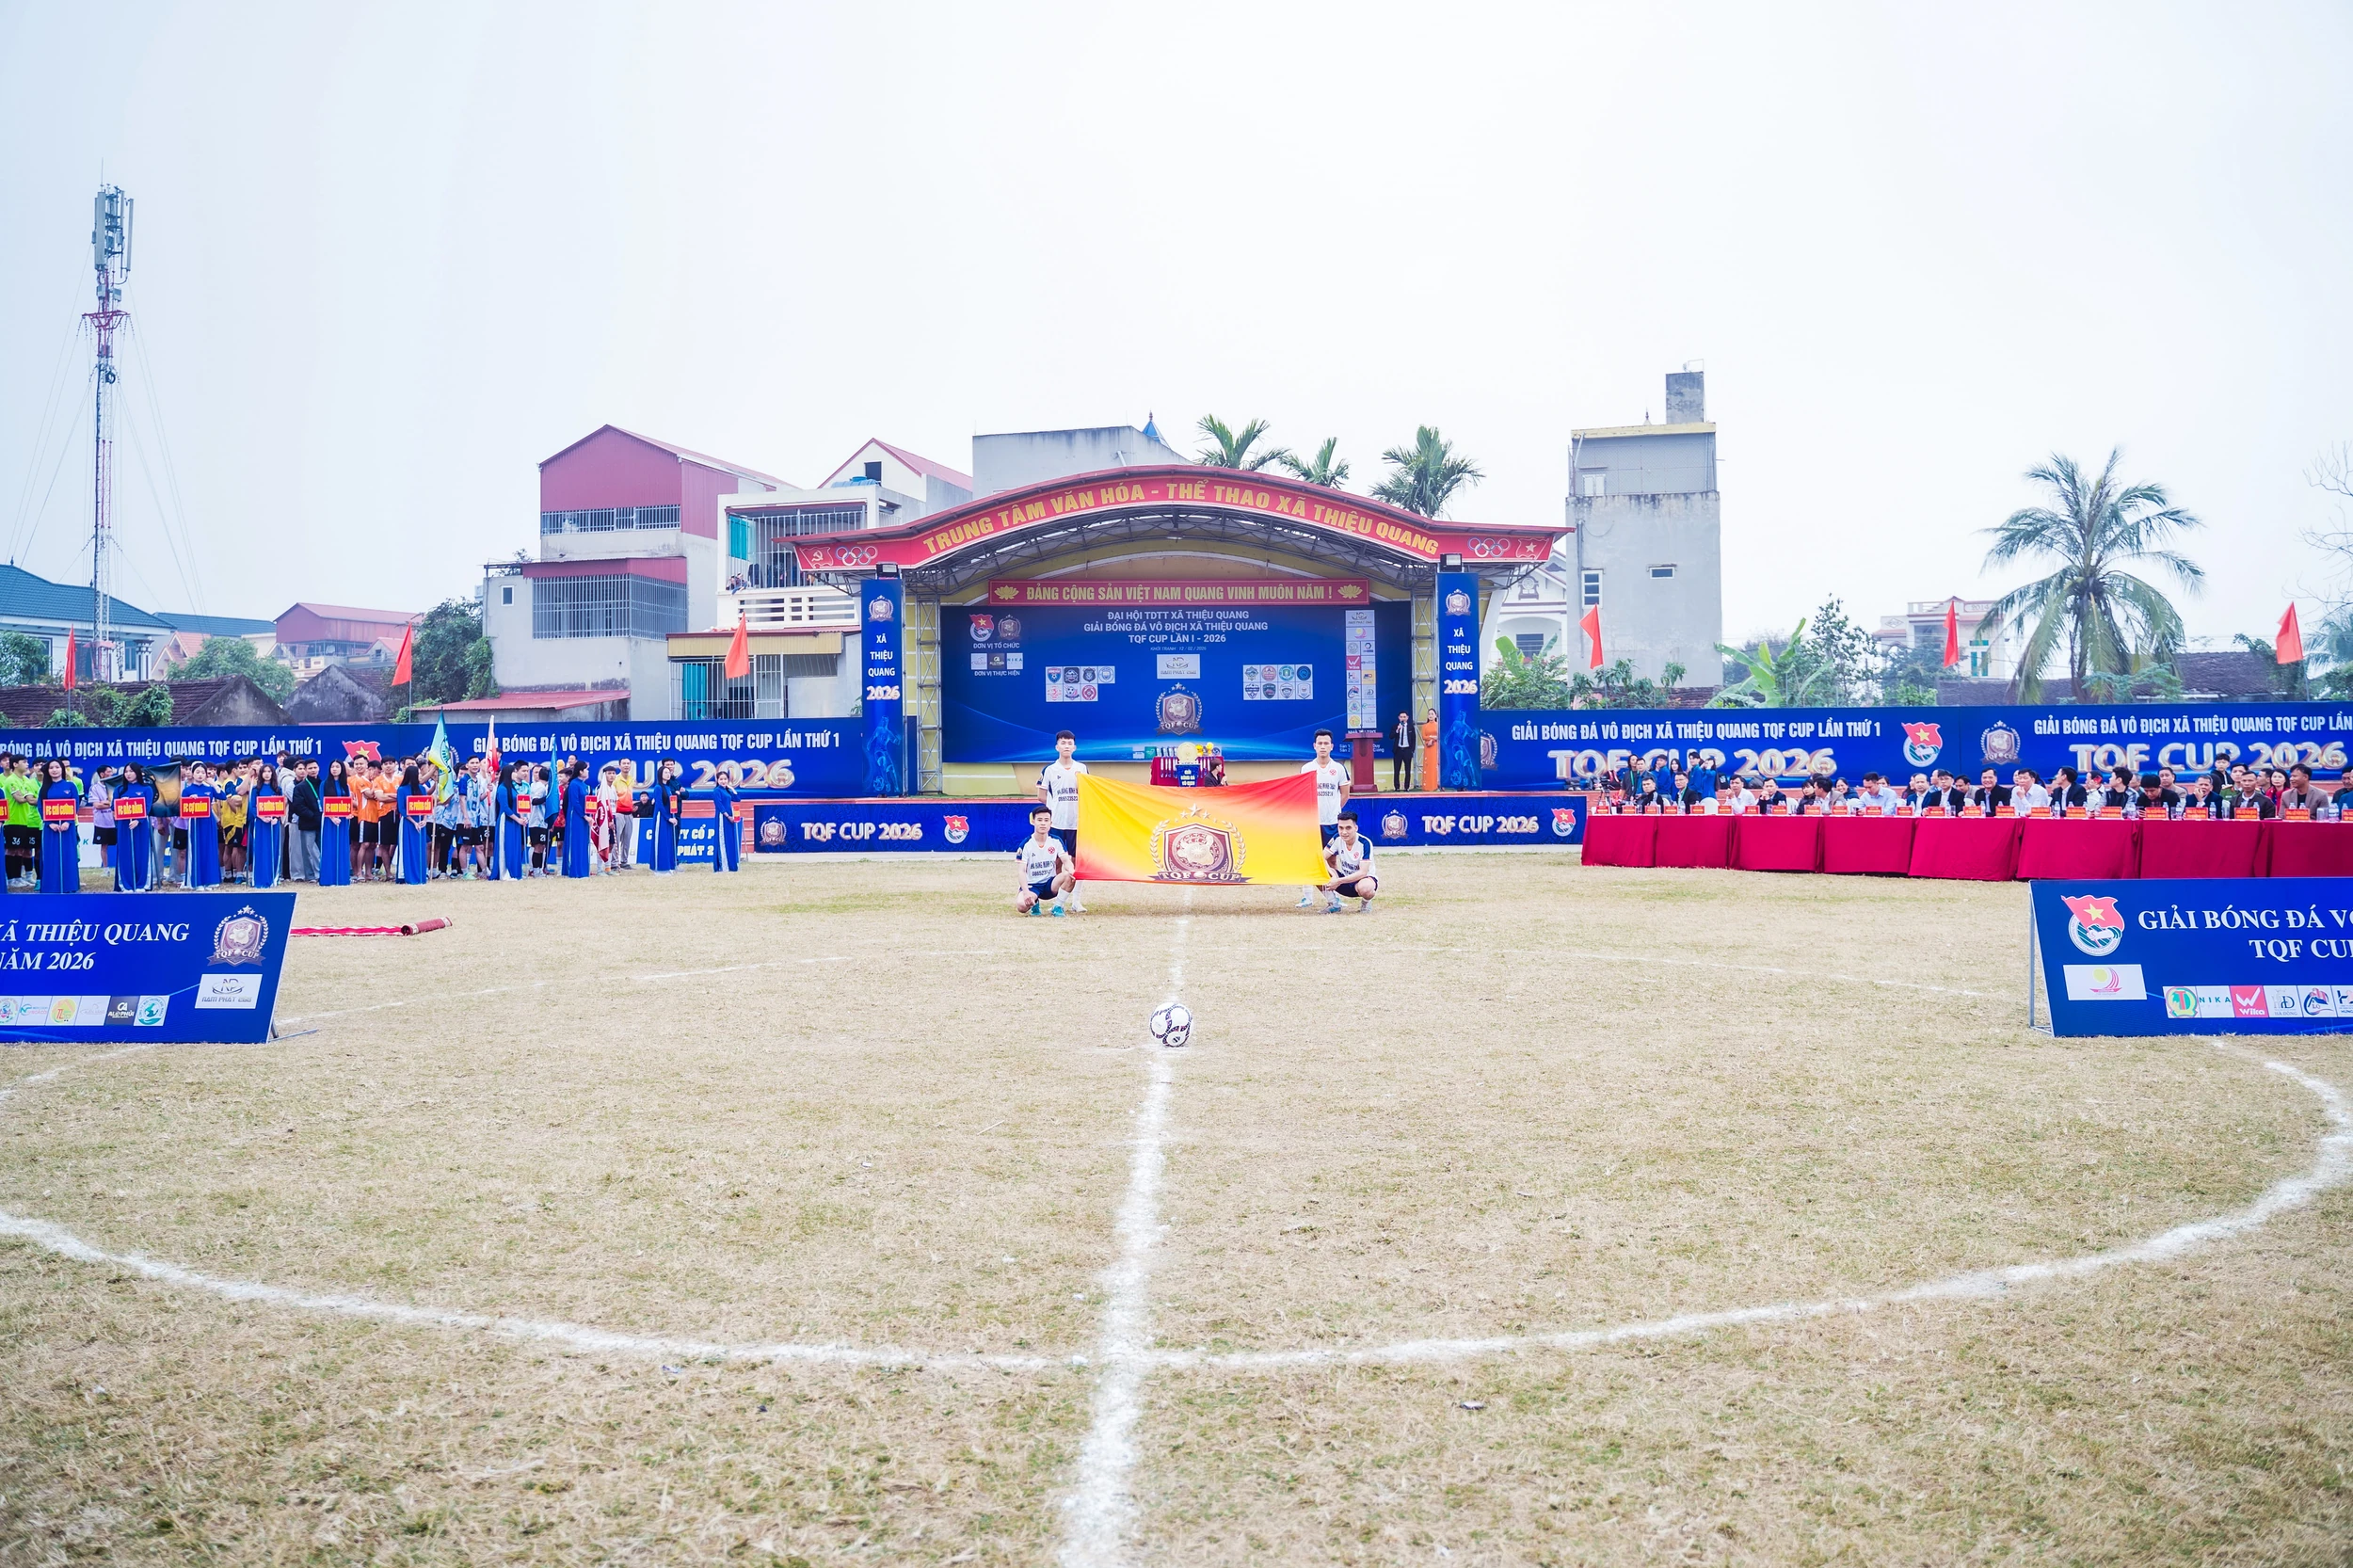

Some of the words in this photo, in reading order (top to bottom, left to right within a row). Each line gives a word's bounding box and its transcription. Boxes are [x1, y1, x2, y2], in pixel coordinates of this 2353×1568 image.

[923, 516, 994, 555] TRUNG
[998, 501, 1046, 529] TÂM
[1051, 487, 1095, 516] VĂN
[1100, 482, 1145, 505] HÓA
[1166, 479, 1209, 500] THỂ
[1214, 485, 1270, 509] THAO
[1275, 496, 1306, 518] XÃ
[1313, 504, 1373, 535] THIỆU
[1375, 520, 1440, 556] QUANG
[1027, 583, 1059, 600] ĐẢNG
[1063, 584, 1095, 603] CỘNG
[1097, 583, 1123, 600] SẢN
[1125, 584, 1150, 602] VIỆT
[1153, 586, 1181, 600] NAM
[1184, 586, 1224, 601] QUANG
[1227, 586, 1255, 600] VINH
[1258, 584, 1294, 600] MUÔN
[1297, 584, 1324, 600] NĂM
[1328, 586, 1333, 599] !
[1107, 611, 1124, 622] ĐẠI
[1126, 610, 1143, 622] HỘI
[1144, 611, 1169, 620] TDTT
[1171, 610, 1184, 619] XÃ
[1186, 610, 1212, 621] THIỆU
[1215, 611, 1249, 620] QUANG
[1083, 621, 1103, 632] GIẢI
[1106, 621, 1131, 632] BÓNG
[1134, 621, 1147, 632] ĐÁ
[1149, 621, 1162, 632] VÔ
[1164, 622, 1188, 633] ĐỊCH
[1190, 621, 1203, 632] XÃ
[1205, 620, 1233, 632] THIỆU
[1234, 622, 1268, 631] QUANG
[1453, 627, 1465, 637] XÃ
[876, 633, 887, 644] XÃ
[1128, 634, 1146, 644] TQF
[1148, 634, 1168, 643] CUP
[1170, 632, 1190, 643] LẦN
[1203, 634, 1226, 643] 2026
[870, 650, 893, 664] THIỆU
[1447, 643, 1471, 656] THIỆU
[868, 667, 896, 678] QUANG
[1445, 662, 1474, 671] QUANG
[866, 685, 901, 701] 2026
[1443, 679, 1479, 695] 2026
[1512, 720, 1538, 741] GIẢI
[1542, 721, 1577, 741] BÓNG
[1580, 721, 1599, 740] ĐÁ
[1601, 721, 1619, 740] VÔ
[1622, 723, 1653, 743] ĐỊCH
[1656, 720, 1673, 740] XÃ
[1676, 720, 1713, 742] THIỆU
[1717, 723, 1760, 740] QUANG
[1762, 722, 1785, 739] TQF
[1788, 722, 1815, 738] CUP
[1817, 717, 1844, 738] LẦN
[1846, 718, 1872, 737] THỨ
[1874, 721, 1881, 737] 1
[2034, 714, 2059, 735] GIẢI
[2063, 715, 2097, 735] BÓNG
[2100, 715, 2118, 734] ĐÁ
[2121, 715, 2137, 734] VÔ
[2140, 717, 2169, 736] ĐỊCH
[2173, 714, 2190, 733] XÃ
[2193, 714, 2228, 736] THIỆU
[2231, 716, 2273, 734] QUANG
[2275, 716, 2297, 732] TQF
[2300, 715, 2326, 731] CUP
[2329, 711, 2353, 731] LẦN
[36, 739, 53, 757] ĐÁ
[56, 739, 72, 757] VÔ
[74, 742, 104, 760] ĐỊCH
[106, 739, 122, 757] XÃ
[126, 738, 161, 760] THIỆU
[164, 740, 205, 758] QUANG
[208, 740, 231, 757] TQF
[232, 740, 258, 756] CUP
[261, 735, 286, 755] LẦN
[288, 736, 313, 755] THỨ
[315, 740, 322, 755] 1
[502, 733, 536, 753] BÓNG
[540, 733, 558, 753] ĐÁ
[561, 733, 577, 752] VÔ
[581, 736, 611, 755] ĐỊCH
[614, 732, 632, 751] XÃ
[634, 731, 671, 754] THIỆU
[674, 734, 717, 752] QUANG
[720, 734, 744, 751] TQF
[746, 733, 773, 749] CUP
[776, 728, 802, 749] LẦN
[805, 729, 831, 748] THỨ
[833, 732, 840, 747] 1
[1733, 747, 1838, 778] 2026
[2158, 741, 2241, 772] CUP
[2248, 741, 2348, 773] 2026
[690, 759, 795, 790] 2026
[801, 822, 837, 842] TQF
[839, 822, 876, 840] CUP
[878, 823, 923, 840] 2026
[1421, 815, 1456, 836] TQF
[1459, 815, 1494, 834] CUP
[1496, 816, 1539, 834] 2026
[11, 837, 21, 846] 36
[677, 842, 705, 856] PHÁT
[1159, 872, 1192, 880] TQF
[1208, 872, 1241, 881] CUP
[2137, 904, 2198, 930] GIẢI
[2201, 904, 2283, 930] BÓNG
[2285, 904, 2326, 929] ĐÁ
[0, 920, 19, 942] Ã
[25, 919, 99, 947] THIỆU
[104, 922, 190, 946] QUANG
[215, 949, 233, 958] TQF
[241, 949, 260, 958] CUP
[2249, 939, 2303, 962] TQF
[47, 952, 96, 970] 2026
